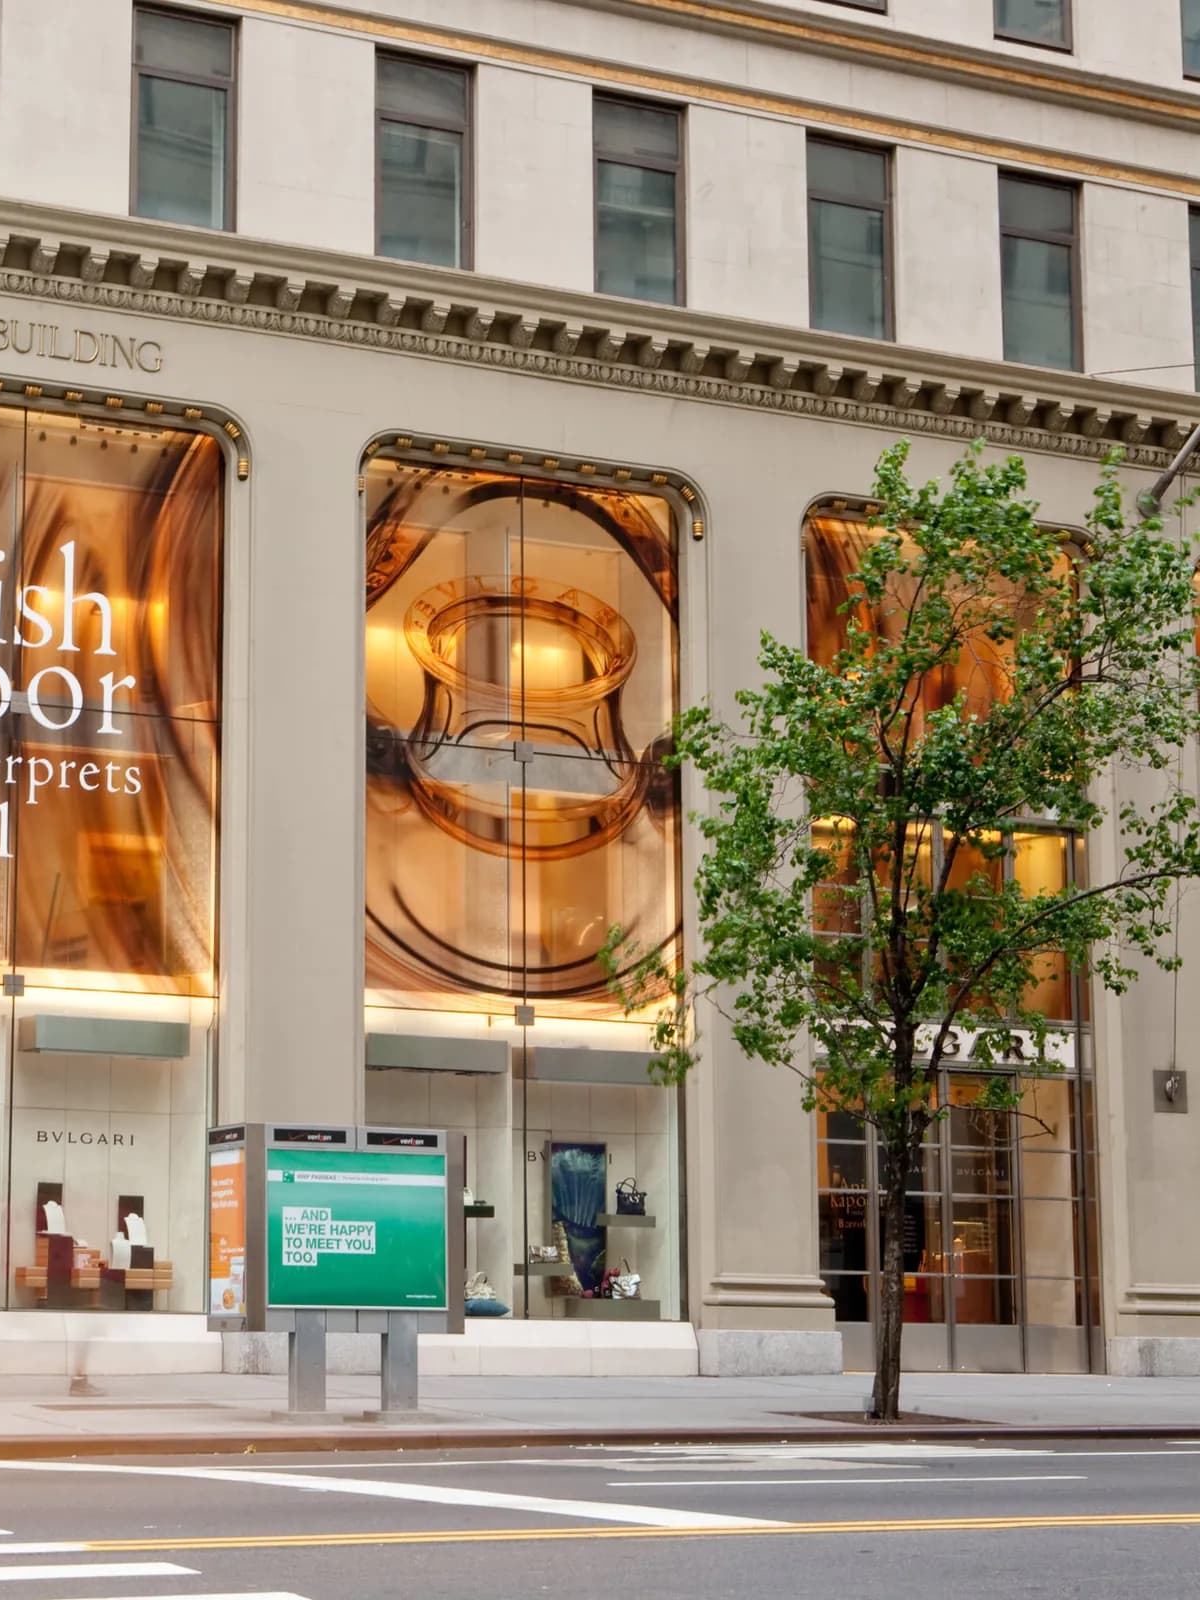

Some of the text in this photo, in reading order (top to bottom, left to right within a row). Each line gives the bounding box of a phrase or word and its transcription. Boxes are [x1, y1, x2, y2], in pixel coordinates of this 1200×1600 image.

[36, 1130, 135, 1146] BVLGARI
[301, 1209, 329, 1221] AND
[285, 1223, 373, 1236] WE'RE HAPPY
[285, 1237, 374, 1252] TO MEET YOU,
[285, 1251, 316, 1263] TOO.
